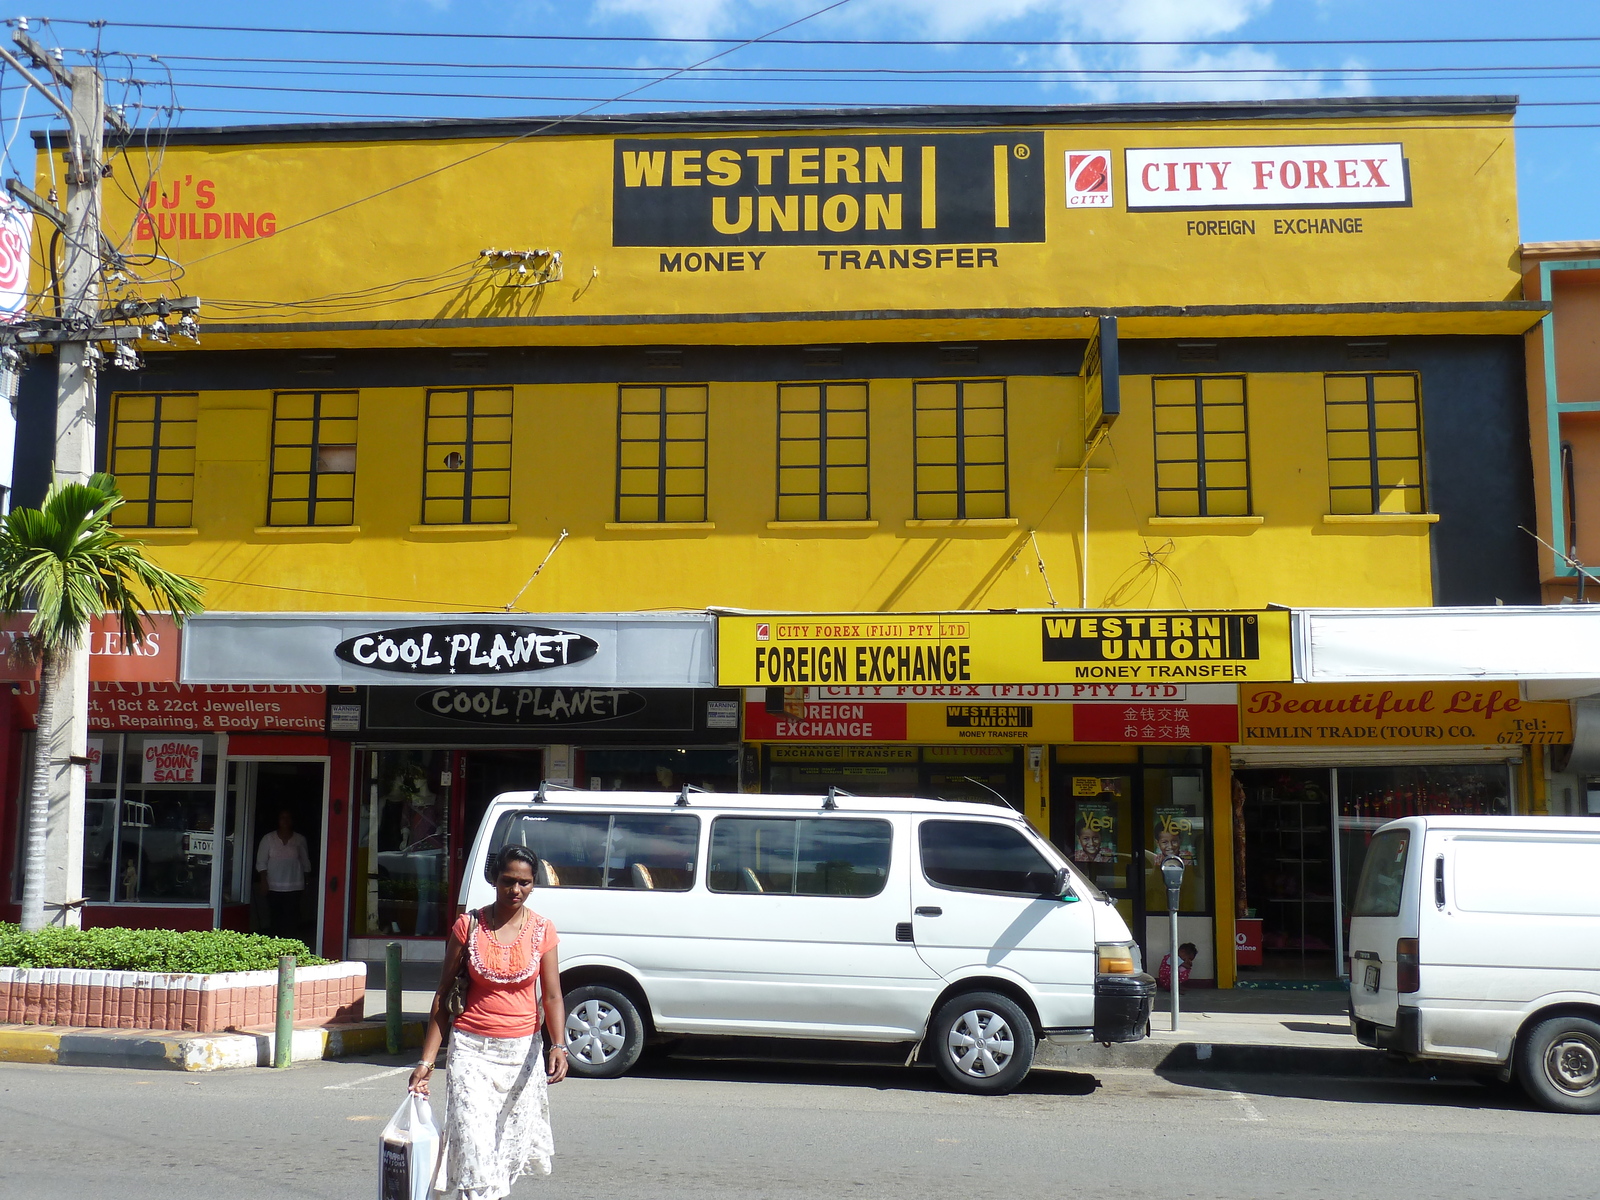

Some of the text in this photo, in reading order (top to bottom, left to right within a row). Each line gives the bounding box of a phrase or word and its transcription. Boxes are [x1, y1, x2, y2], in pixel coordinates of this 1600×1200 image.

[622, 146, 903, 187] WESTERN
[1141, 158, 1390, 192] CITY FOREX
[138, 174, 216, 210] JJ'S
[1070, 194, 1109, 205] CITY
[711, 193, 903, 235] UNION
[136, 211, 277, 240] BUILDING
[1186, 217, 1363, 236] FOREIGN EXCHANGE
[659, 248, 999, 273] MONEY TRANSFER
[779, 625, 966, 638] CITY FOREX (FIJI) PTY LTD
[1045, 617, 1221, 638] WESTERN
[353, 631, 581, 667] COOL PLANET
[1101, 638, 1221, 660] UNION
[755, 645, 971, 683] FOREIGN EXCHANGE
[1075, 664, 1248, 678] MONEY TRANSFER
[826, 684, 1179, 698] CITY FOREX (FIJI) PTY LTD
[108, 699, 142, 712] 18ct
[147, 700, 160, 712] &
[163, 700, 198, 712] 22ct
[202, 700, 281, 713] Jewellers
[432, 687, 630, 718] COOL PLANET
[1246, 690, 1523, 720] Beautiful Life
[947, 706, 1019, 717] WESTERN
[1123, 707, 1190, 722] 金钱交换
[119, 714, 201, 729] Repairing,
[202, 714, 215, 727] &
[219, 715, 260, 729] Body
[263, 715, 326, 730] Piercing
[776, 722, 873, 737] EXCHANGE
[969, 717, 1018, 726] UNION
[959, 730, 1028, 738] MONEY TRANSFER
[1124, 723, 1191, 739] お金交換
[1246, 725, 1313, 739] KIMLIN
[1447, 726, 1476, 738] CO.
[1497, 731, 1564, 744] 672 7777
[146, 743, 199, 761] CLOSING
[850, 750, 913, 758] TRANSFER
[156, 755, 192, 769] DOWN
[154, 769, 195, 782] SALE
[1082, 811, 1114, 833] Yes!
[1159, 814, 1192, 836] Yes!
